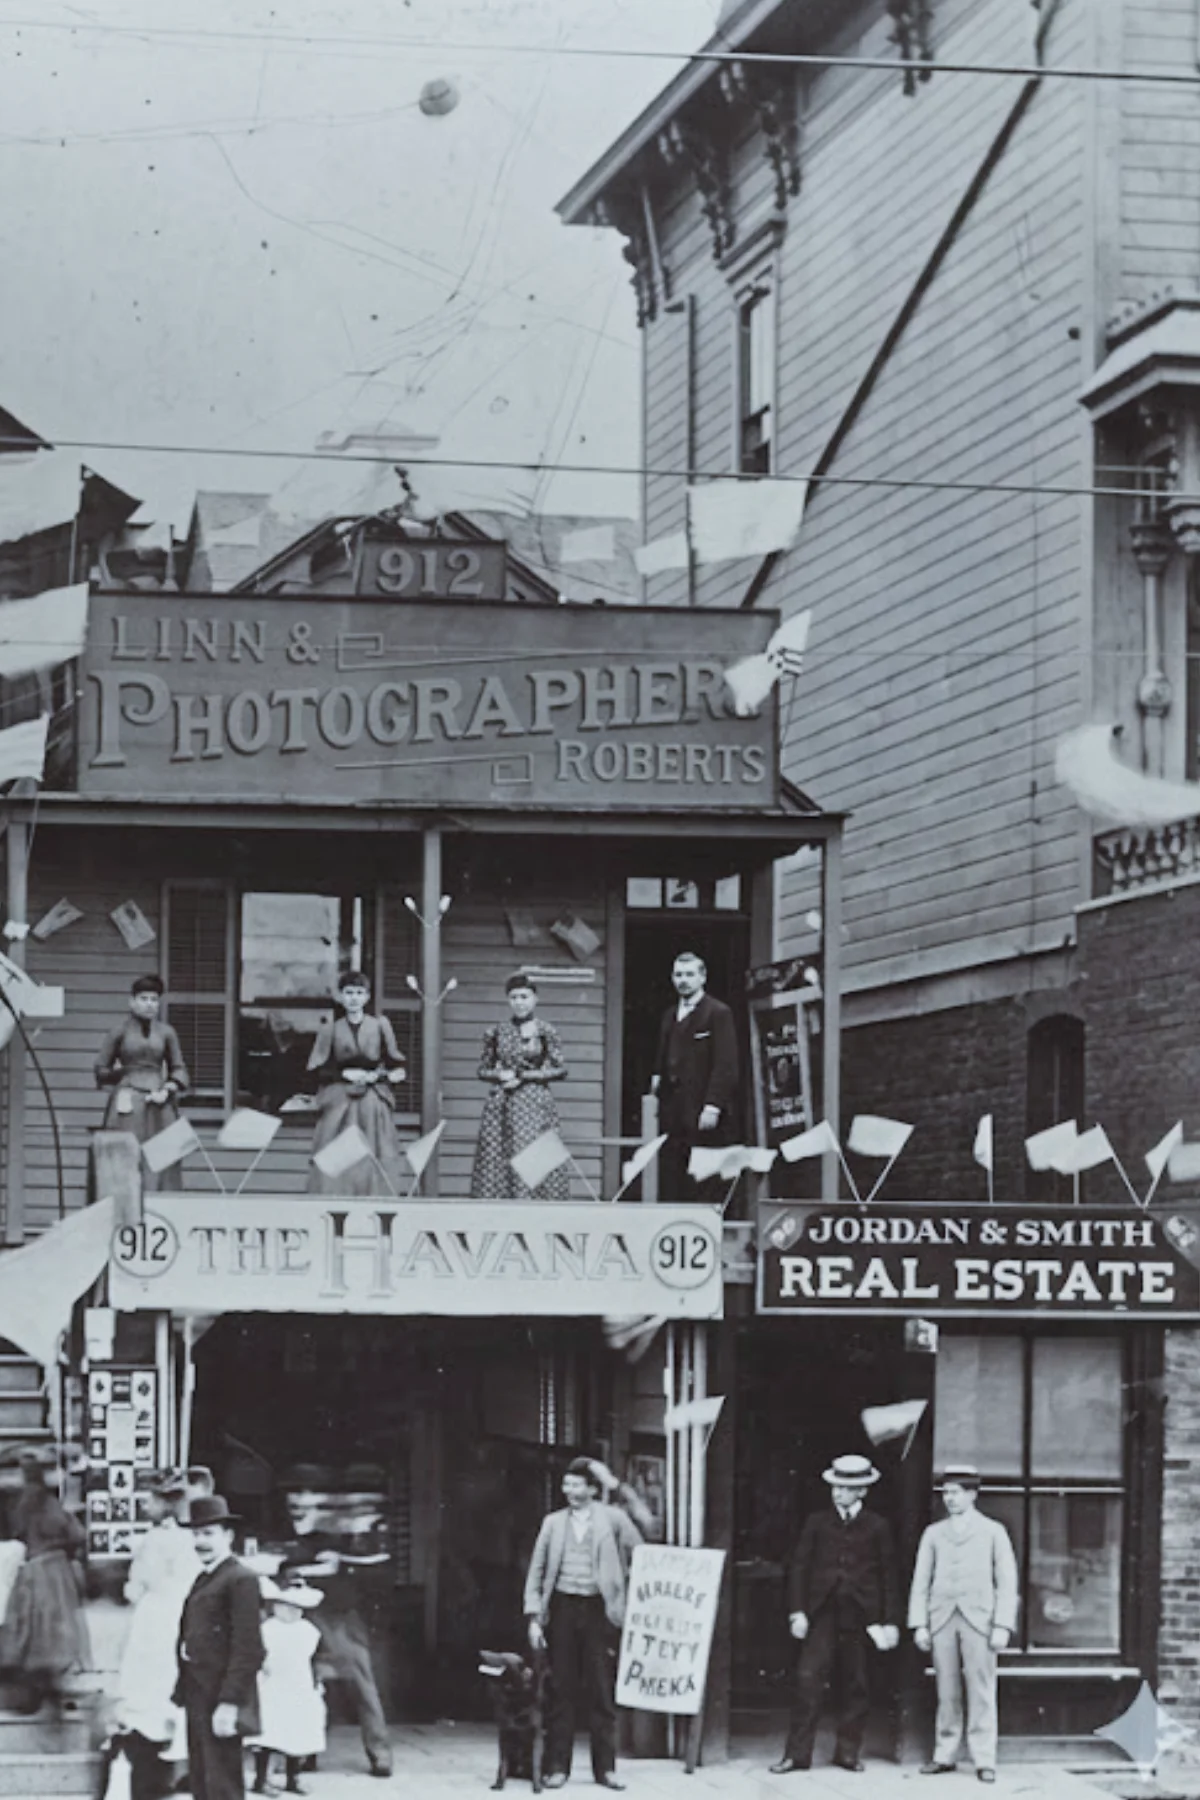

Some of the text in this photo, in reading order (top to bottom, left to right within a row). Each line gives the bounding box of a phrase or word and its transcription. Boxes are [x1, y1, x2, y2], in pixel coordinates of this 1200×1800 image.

[376, 548, 484, 595] 912
[111, 615, 321, 664] LINN &
[87, 660, 763, 769] PHOTOGRAPHER
[556, 738, 766, 785] ROBERTS
[119, 1222, 169, 1262] 912
[188, 1227, 312, 1275] THE
[658, 1234, 708, 1269] 912
[809, 1217, 1155, 1247] JORDAN & SMITH
[779, 1256, 1176, 1305] REAL ESTATE
